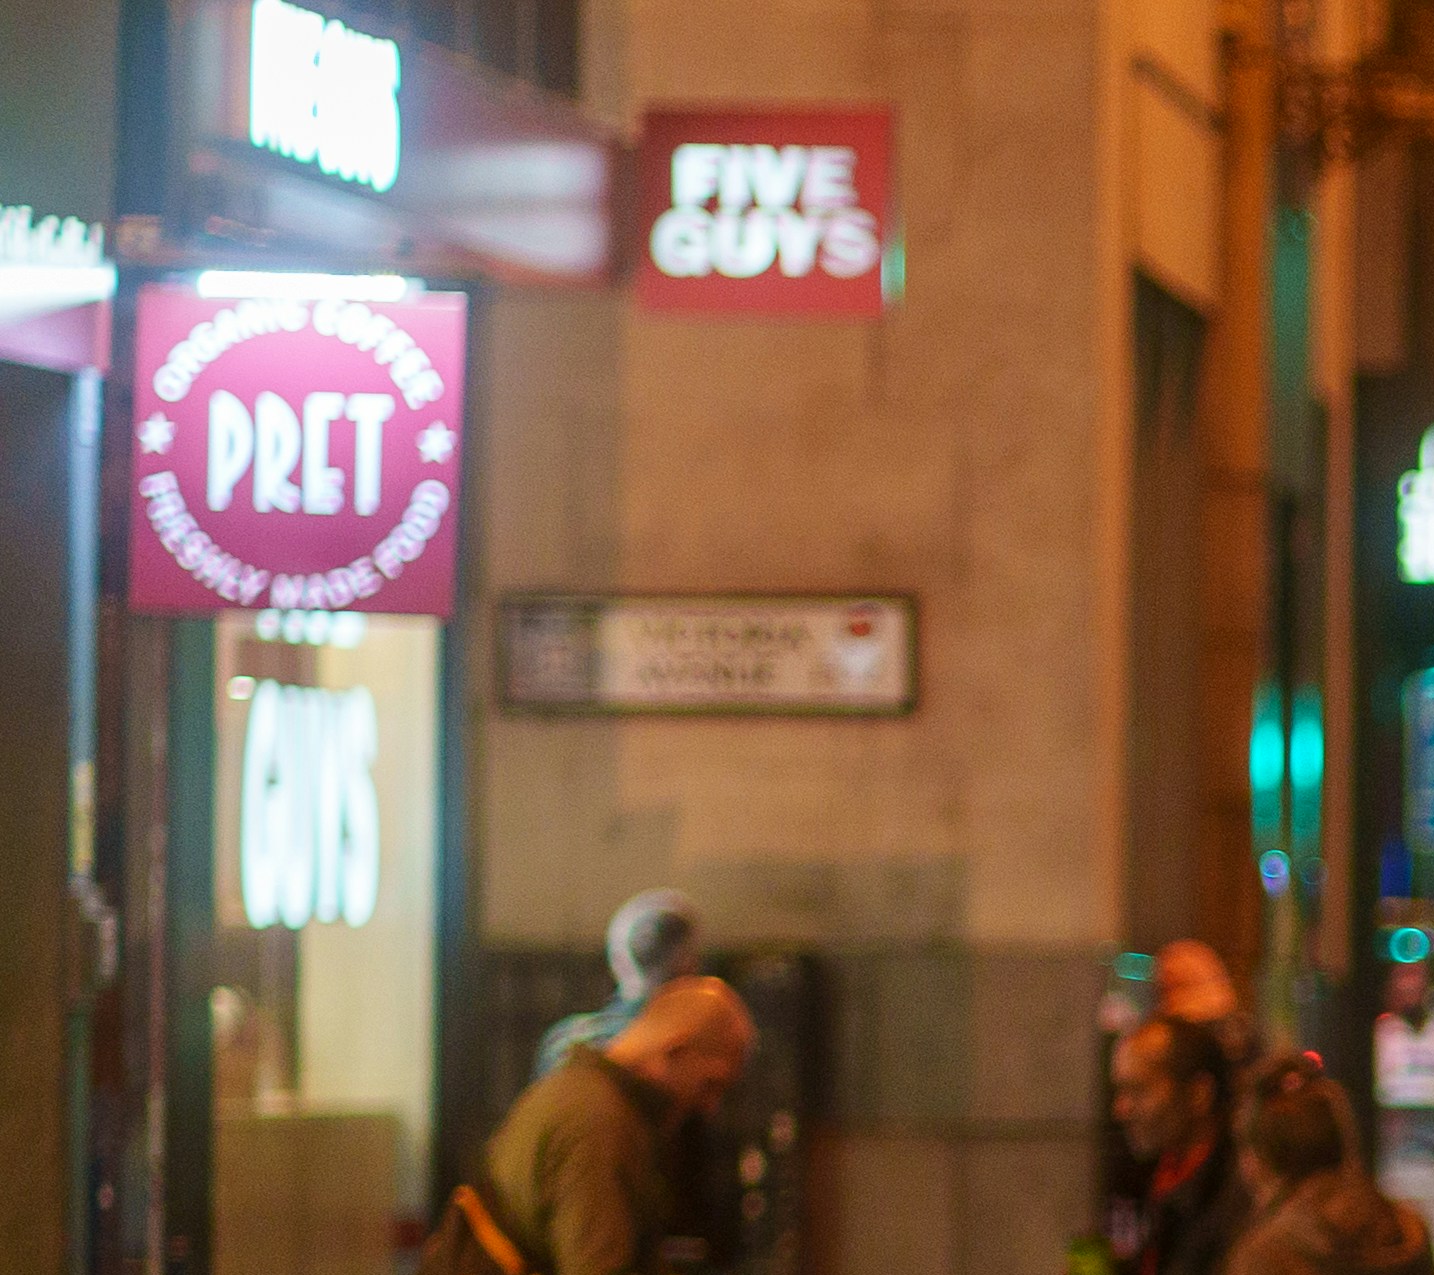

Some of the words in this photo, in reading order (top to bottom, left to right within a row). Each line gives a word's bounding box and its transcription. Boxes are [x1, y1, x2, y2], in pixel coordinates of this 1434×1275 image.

[670, 143, 858, 207] FIVE
[651, 205, 880, 279] GUYS
[206, 389, 395, 516] PRET
